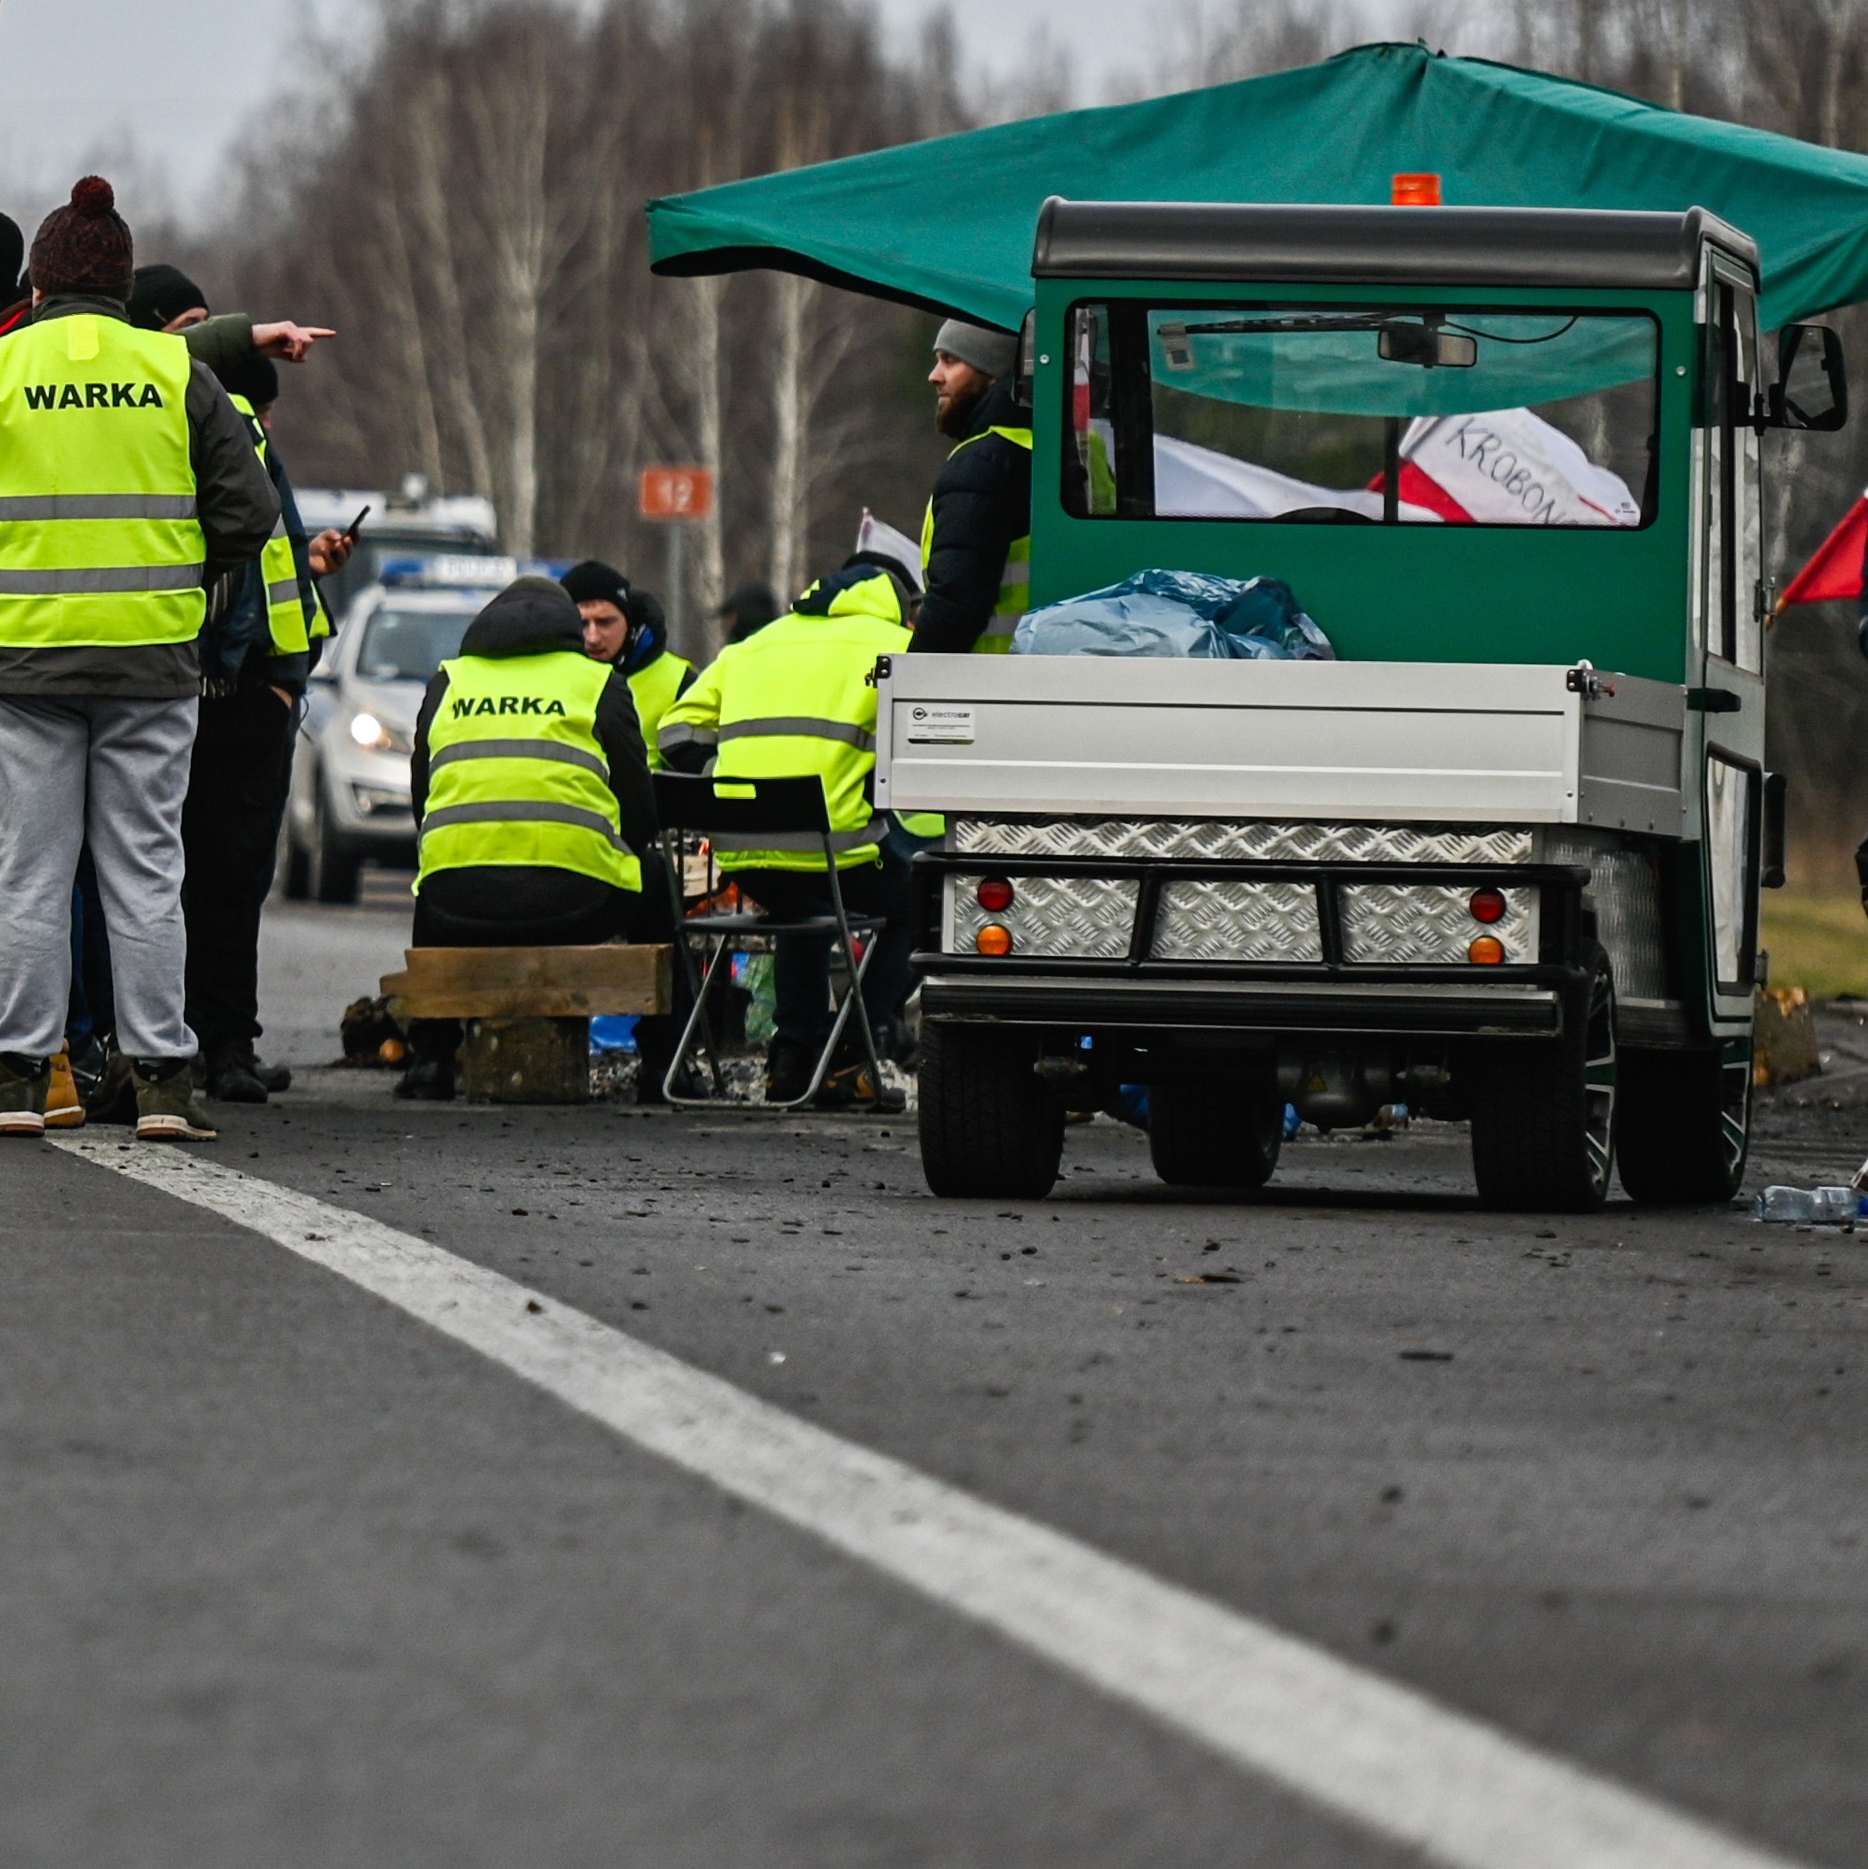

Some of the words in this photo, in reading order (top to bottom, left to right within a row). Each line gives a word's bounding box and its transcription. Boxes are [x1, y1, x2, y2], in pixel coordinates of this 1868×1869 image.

[23, 382, 163, 410] WARKA
[1445, 417, 1580, 524] KROBON
[452, 696, 567, 720] WARKA
